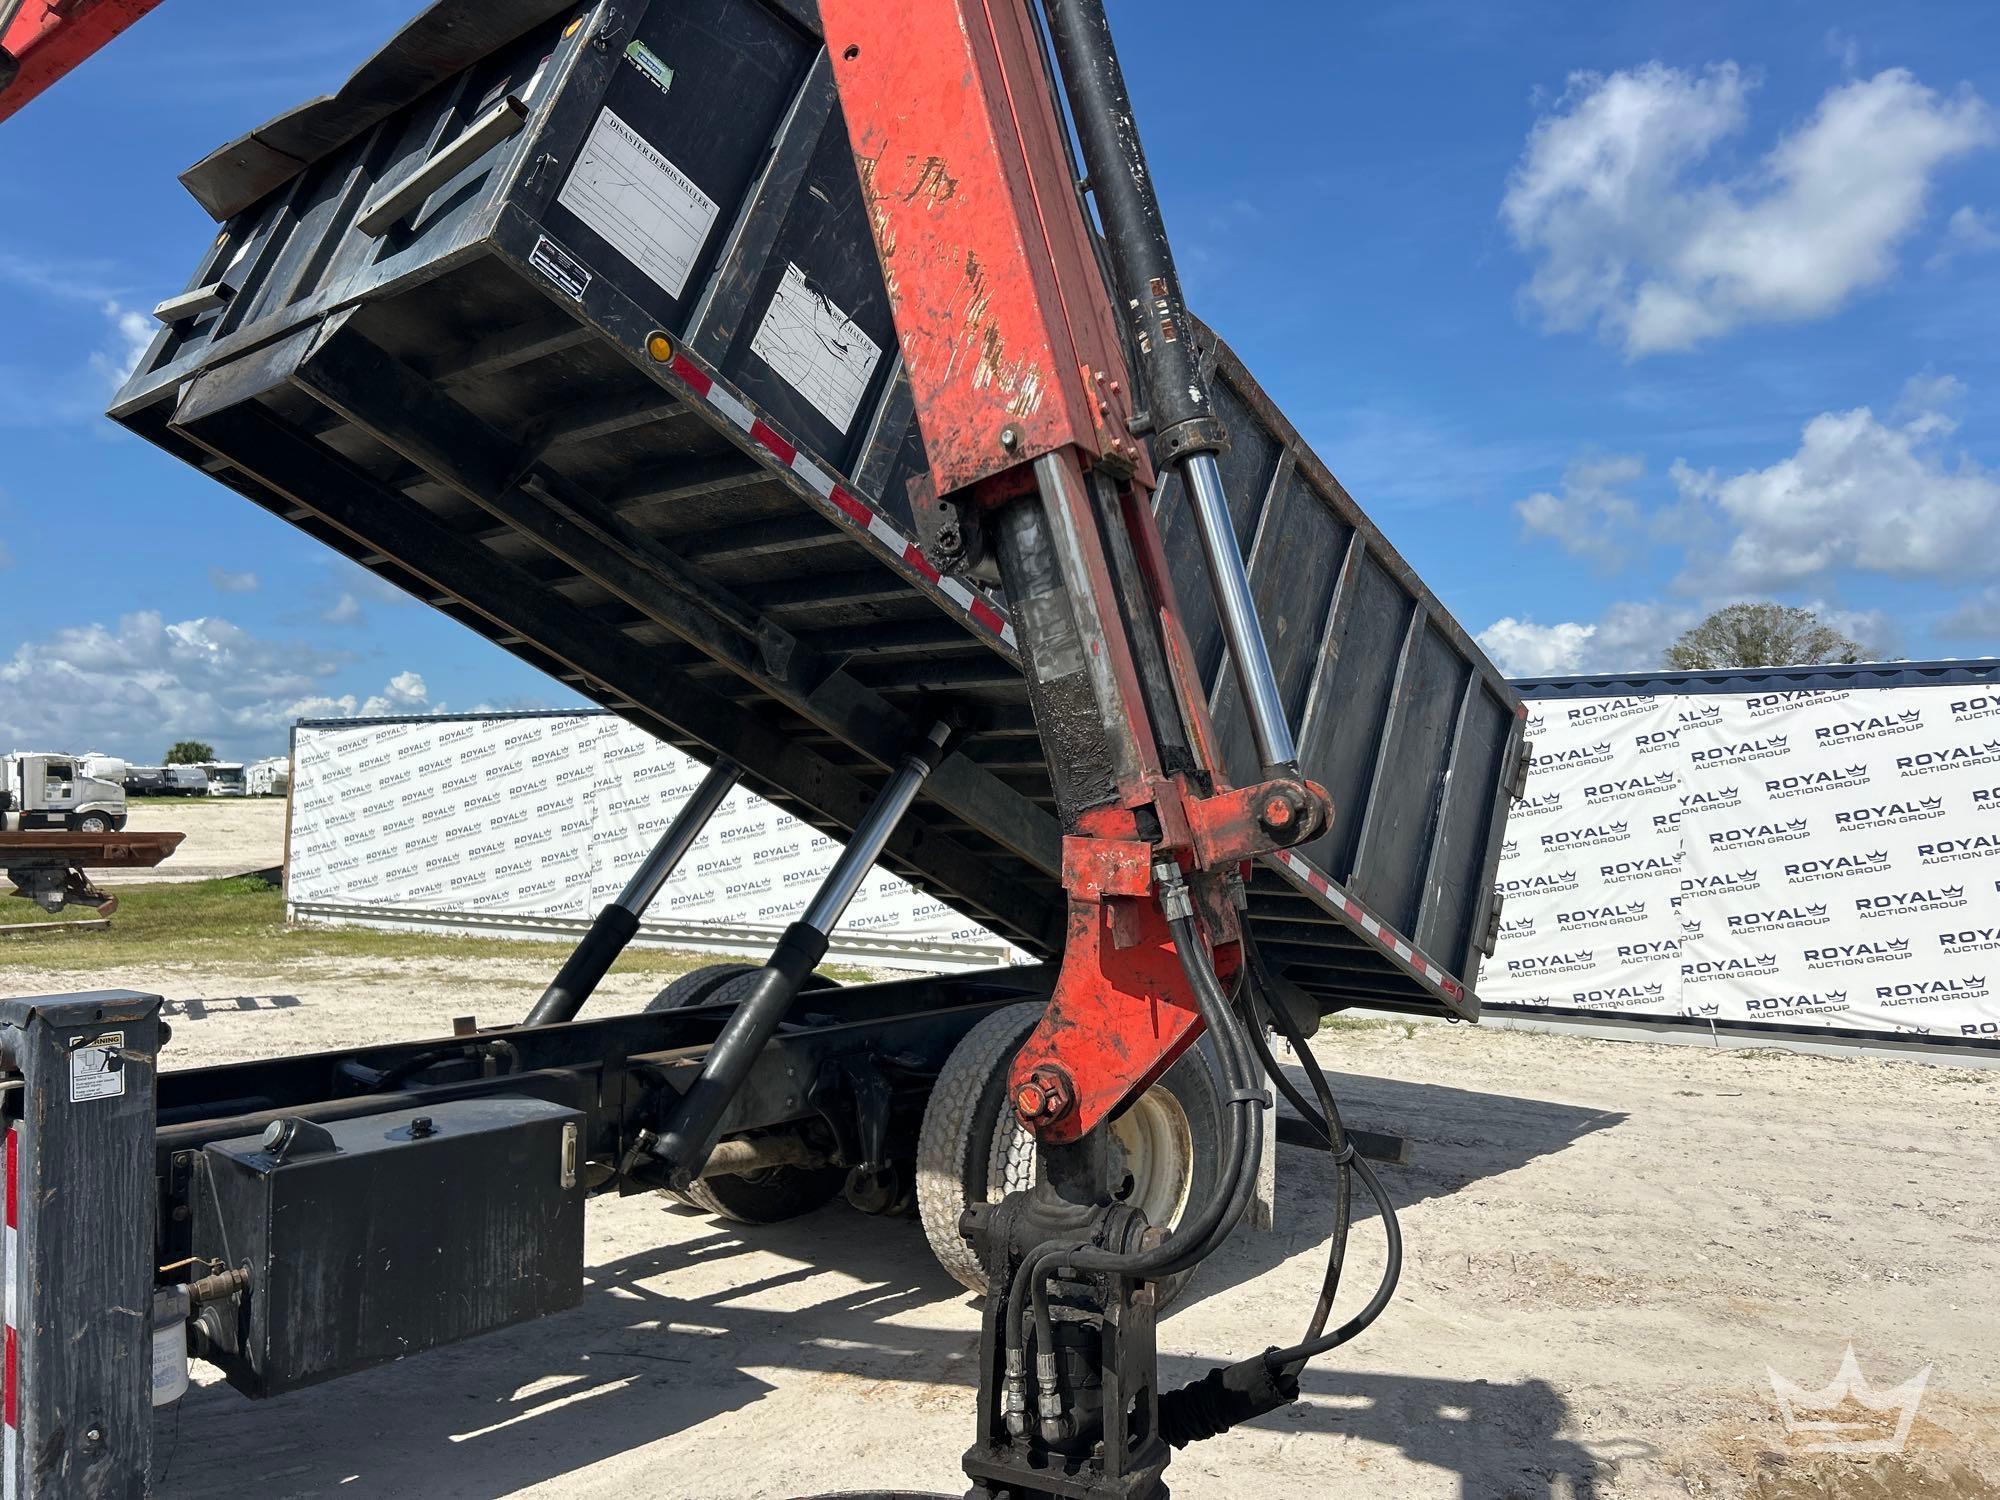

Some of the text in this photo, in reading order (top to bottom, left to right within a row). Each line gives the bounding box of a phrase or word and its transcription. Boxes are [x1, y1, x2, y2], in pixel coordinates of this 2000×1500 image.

[610, 118, 708, 209] DISASTER DEBRIS HAULER
[848, 324, 873, 352] HAULER
[1568, 698, 1638, 720] ROYAL
[1750, 693, 1849, 718] AUCTION GROUP
[1950, 696, 2000, 714] ROY
[1570, 704, 1659, 728] AUCTION GROUP
[1955, 708, 2000, 722] AUCTIO
[551, 718, 580, 731] ROYAL
[1683, 718, 1723, 731] GROUP
[1815, 716, 1898, 739] ROYAL
[376, 728, 400, 740] ROYAL
[439, 729, 466, 742] ROYAL
[505, 733, 533, 745] ROYAL
[1525, 728, 1546, 736] OUP
[1636, 729, 1680, 746] ROY
[1819, 723, 1924, 747] AUCTION GROUP
[337, 741, 361, 752] ROYAL
[398, 743, 423, 755] ROYAL
[461, 746, 488, 759] ROYAL
[604, 745, 635, 758] ROYAL
[1638, 742, 1680, 754] AUCTIO
[1691, 741, 1767, 762] ROYAL
[359, 756, 383, 768] ROYAL
[532, 750, 561, 763] ROYAL
[1528, 748, 1593, 766] ROYAL
[1694, 748, 1790, 770] AUCTION GROUP
[1896, 746, 1984, 769] ROYAL
[634, 764, 666, 778] ROYAL
[1528, 754, 1614, 776] AUCTION GROUP
[1900, 755, 2000, 777] AUCTION GROU
[557, 768, 585, 781] ROYAL
[1766, 770, 1846, 792] ROYAL
[341, 786, 365, 797] ROYAL
[510, 782, 538, 795] ROYAL
[661, 784, 694, 798] ROYAL
[1584, 777, 1655, 797] ROYAL
[1769, 778, 1870, 800] AUCTION GROUP
[464, 795, 492, 807] ROYAL
[1587, 784, 1676, 806] AUCTION GROUP
[1680, 792, 1719, 806] YAL
[363, 803, 387, 813] ROYAL
[609, 798, 641, 810] ROYAL
[1509, 797, 1543, 811] YAL
[1527, 805, 1563, 817] GROUP
[1701, 800, 1741, 812] GROUP
[1835, 802, 1920, 823] ROYAL
[1839, 811, 1945, 832] AUCTION GROUP
[345, 831, 368, 842] ROYAL
[446, 825, 472, 837] ROYAL
[515, 832, 544, 844] ROYAL
[721, 825, 756, 838] ROYAL
[1541, 826, 1609, 846] ROYAL
[1709, 824, 1786, 844] ROYAL
[722, 835, 746, 844] AUCTION
[1544, 833, 1630, 854] AUCTION GROUP
[1713, 832, 1810, 852] AUCTION GROUP
[366, 849, 391, 860] ROYAL
[469, 844, 497, 856] ROYAL
[541, 851, 570, 863] ROYAL
[753, 846, 789, 860] ROYAL
[1500, 852, 1520, 860] OUP
[754, 856, 779, 865] AUCTION
[1784, 854, 1867, 876] ROYAL
[1922, 851, 1981, 865] AUCTION
[697, 859, 732, 872] ROYAL
[698, 868, 722, 877] AUCTION
[1600, 856, 1672, 876] ROYAL
[451, 875, 478, 885] ROYAL
[783, 869, 820, 882] ROYAL
[1603, 867, 1681, 884] AUCTION GRO
[1788, 864, 1891, 884] AUCTION GROUP
[519, 882, 547, 894] ROYAL
[726, 881, 761, 894] ROYAL
[1494, 875, 1559, 894] ROYAL
[1681, 874, 1738, 891] OYAL
[727, 891, 751, 900] AUCTION
[1502, 883, 1579, 900] UCTION GROUP
[1681, 883, 1760, 900] CTION GROUP
[671, 893, 705, 905] ROYAL
[1856, 890, 1942, 910] ROYAL
[672, 902, 695, 911] AUCTION
[1859, 900, 1967, 919] AUCTION GROUP
[849, 915, 887, 927] ROYAL
[1557, 906, 1627, 924] ROYAL
[1728, 908, 1806, 927] ROYAL
[1560, 914, 1648, 932] AUCTION GROUP
[1731, 917, 1830, 935] AUCTION GROUP
[952, 927, 993, 939] ROYA
[1500, 930, 1536, 940] GROUP
[1681, 933, 1704, 942] OUP
[1939, 928, 2000, 945] ROY
[1617, 940, 1681, 956] ROYA
[1804, 943, 1888, 961] ROYAL
[1508, 954, 1576, 971] ROYAL
[1620, 954, 1670, 965] AUCTION
[1681, 958, 1756, 975] ROYAL
[1808, 953, 1912, 970] AUCTION GROUP
[1511, 963, 1596, 979] AUCTION GROUP
[1684, 968, 1779, 984] AUCTION GROUP
[1573, 986, 1644, 1003] ROYAL
[1876, 980, 1963, 998] ROYAL
[1626, 996, 1664, 1007] GROUP
[1746, 994, 1826, 1010] ROYAL
[1880, 990, 1989, 1007] AUCTION GROUP
[1750, 1004, 1850, 1019] AUCTION GROUP
